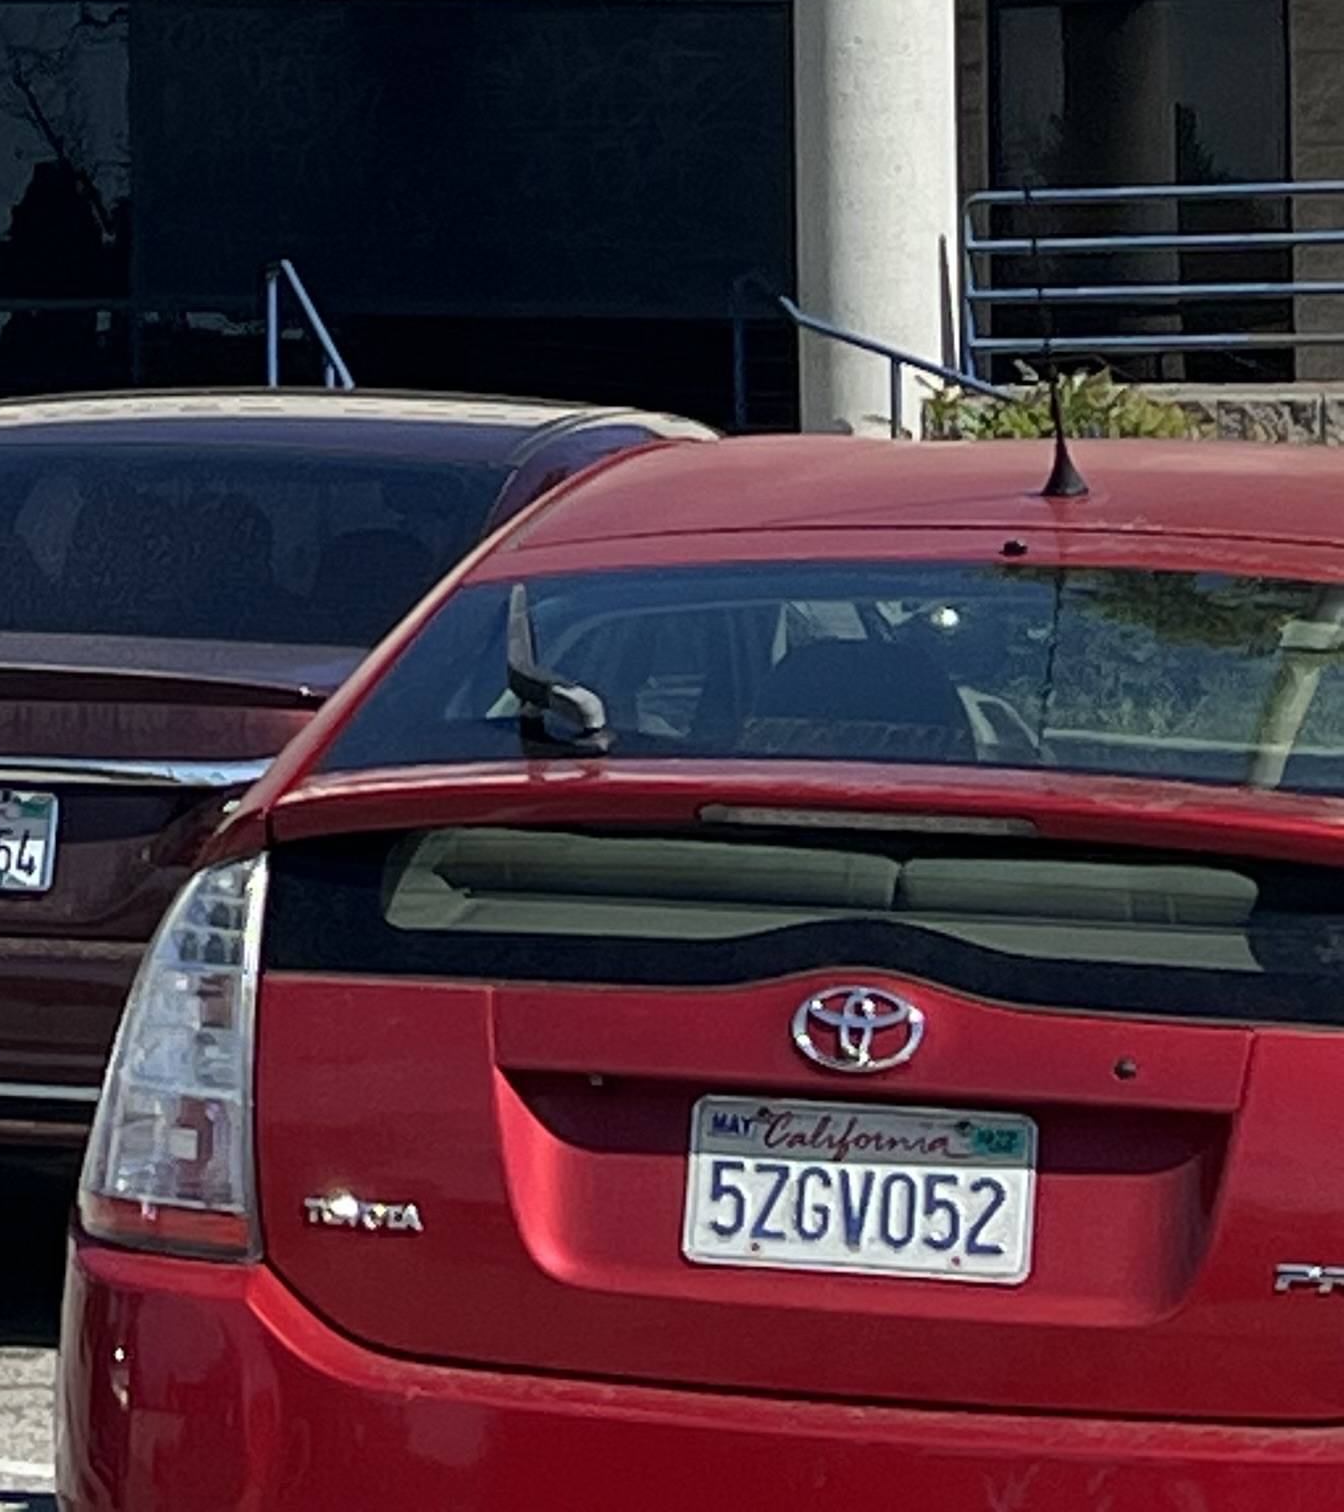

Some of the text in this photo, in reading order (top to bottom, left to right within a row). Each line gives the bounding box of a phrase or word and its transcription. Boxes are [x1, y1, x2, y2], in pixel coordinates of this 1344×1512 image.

[711, 1112, 753, 1135] MAY
[762, 1110, 972, 1162] California
[707, 1159, 1010, 1256] 5ZGV052
